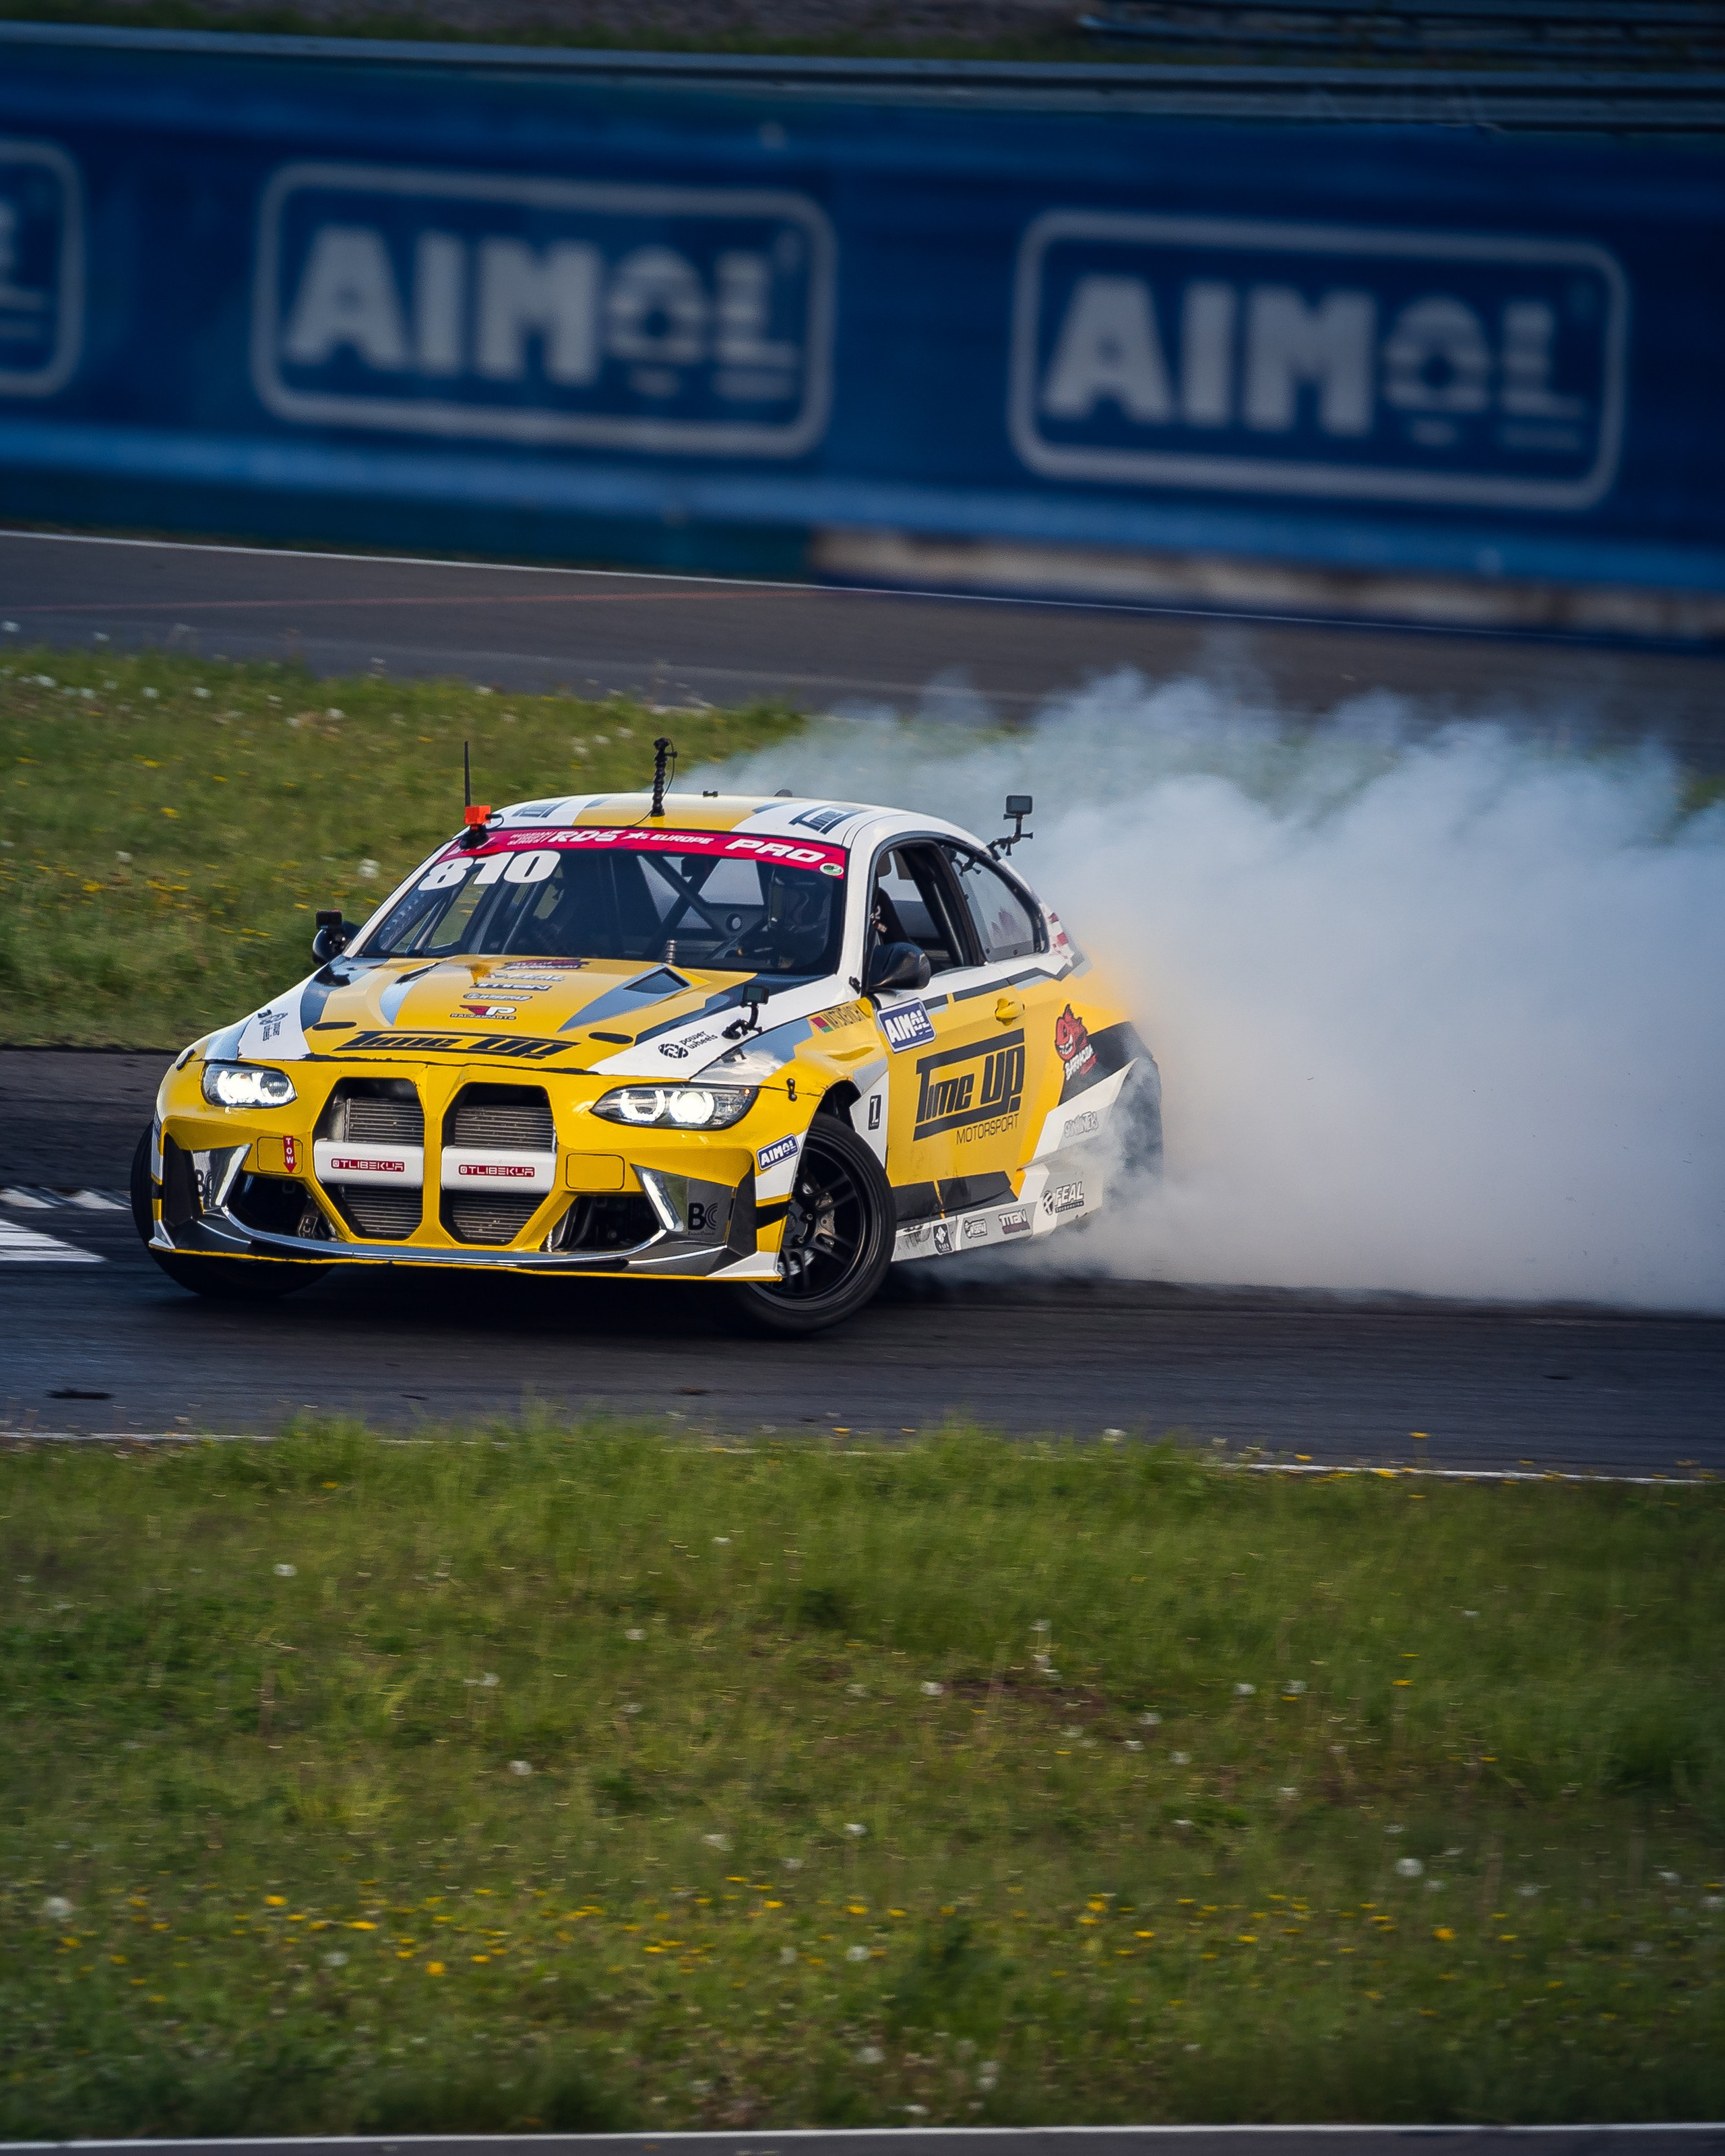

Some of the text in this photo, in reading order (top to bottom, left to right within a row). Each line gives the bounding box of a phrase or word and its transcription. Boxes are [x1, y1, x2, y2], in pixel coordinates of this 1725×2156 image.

[650, 833, 714, 844] EUROPE
[724, 838, 826, 862] PRO
[418, 850, 561, 891] 810
[679, 1031, 708, 1046] power
[884, 1009, 931, 1044] AIMOL
[687, 1034, 718, 1049] wheels
[956, 1113, 1020, 1145] MOTORSPORT
[286, 1137, 294, 1164] TOW
[1055, 1181, 1084, 1206] FEAL
